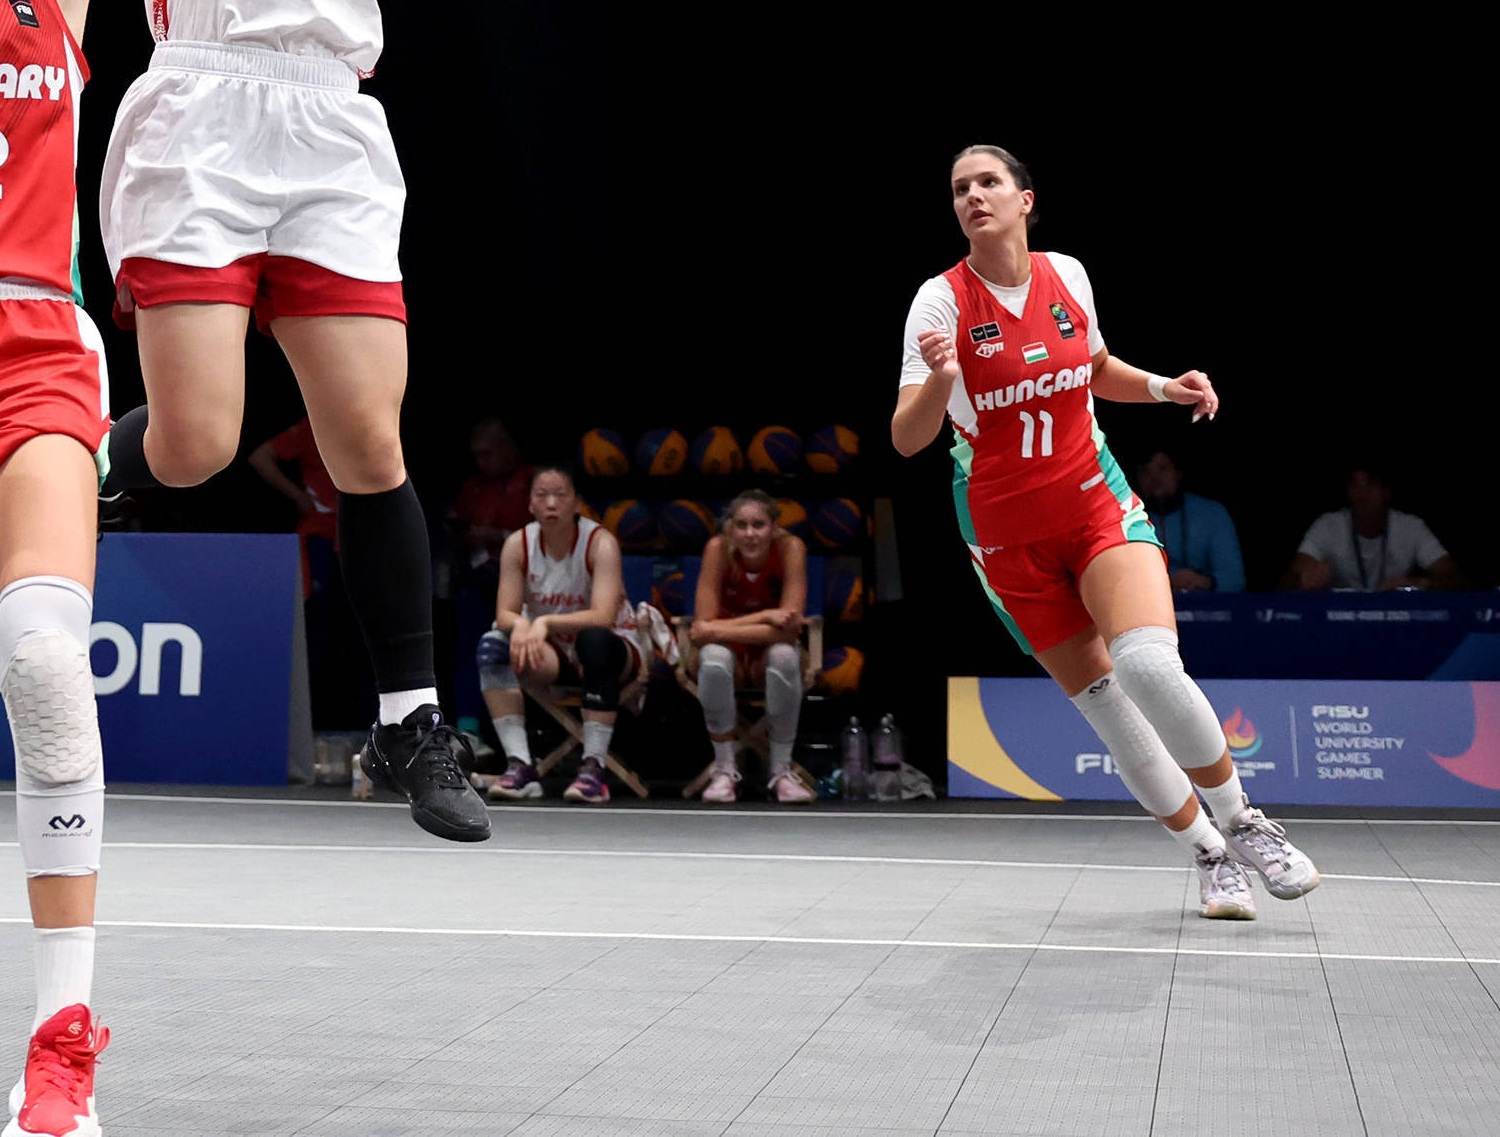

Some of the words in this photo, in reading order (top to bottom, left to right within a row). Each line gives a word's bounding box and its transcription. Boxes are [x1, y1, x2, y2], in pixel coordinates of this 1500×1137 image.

[1019, 410, 1054, 459] 11
[1311, 705, 1370, 719] FISU
[1313, 721, 1373, 736] WORLD
[1314, 737, 1405, 751] UNIVERSITY
[1316, 752, 1372, 765] GAMES
[1317, 767, 1385, 780] SUMMER
